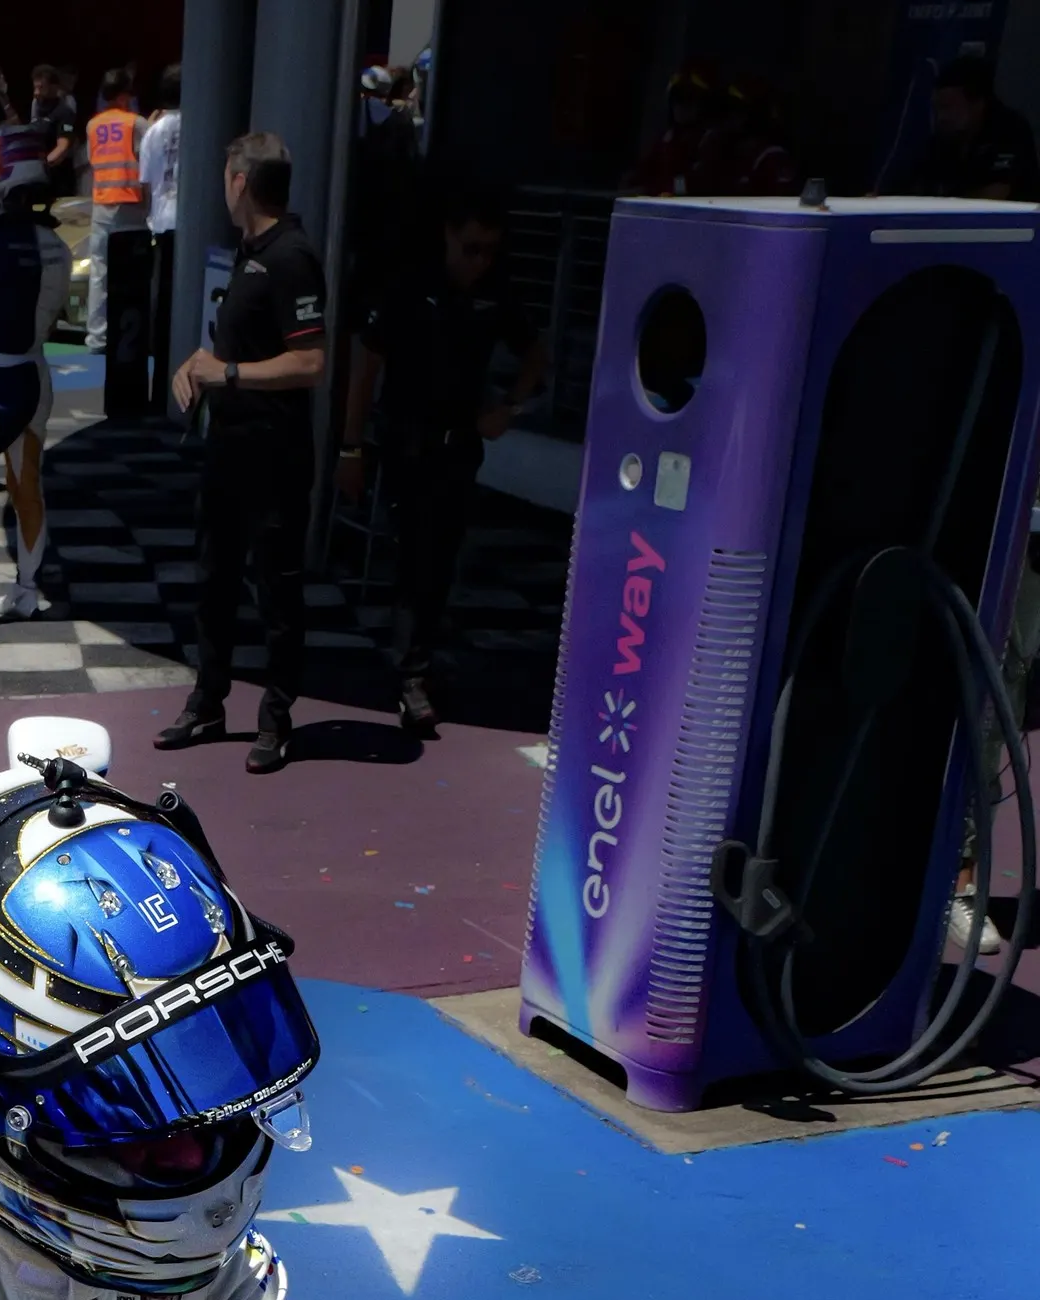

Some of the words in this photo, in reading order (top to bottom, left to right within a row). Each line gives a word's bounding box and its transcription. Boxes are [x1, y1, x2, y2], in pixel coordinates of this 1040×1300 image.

[97, 122, 124, 145] 95
[613, 530, 666, 675] way
[583, 764, 626, 919] enel
[73, 940, 291, 1064] PORSCHE
